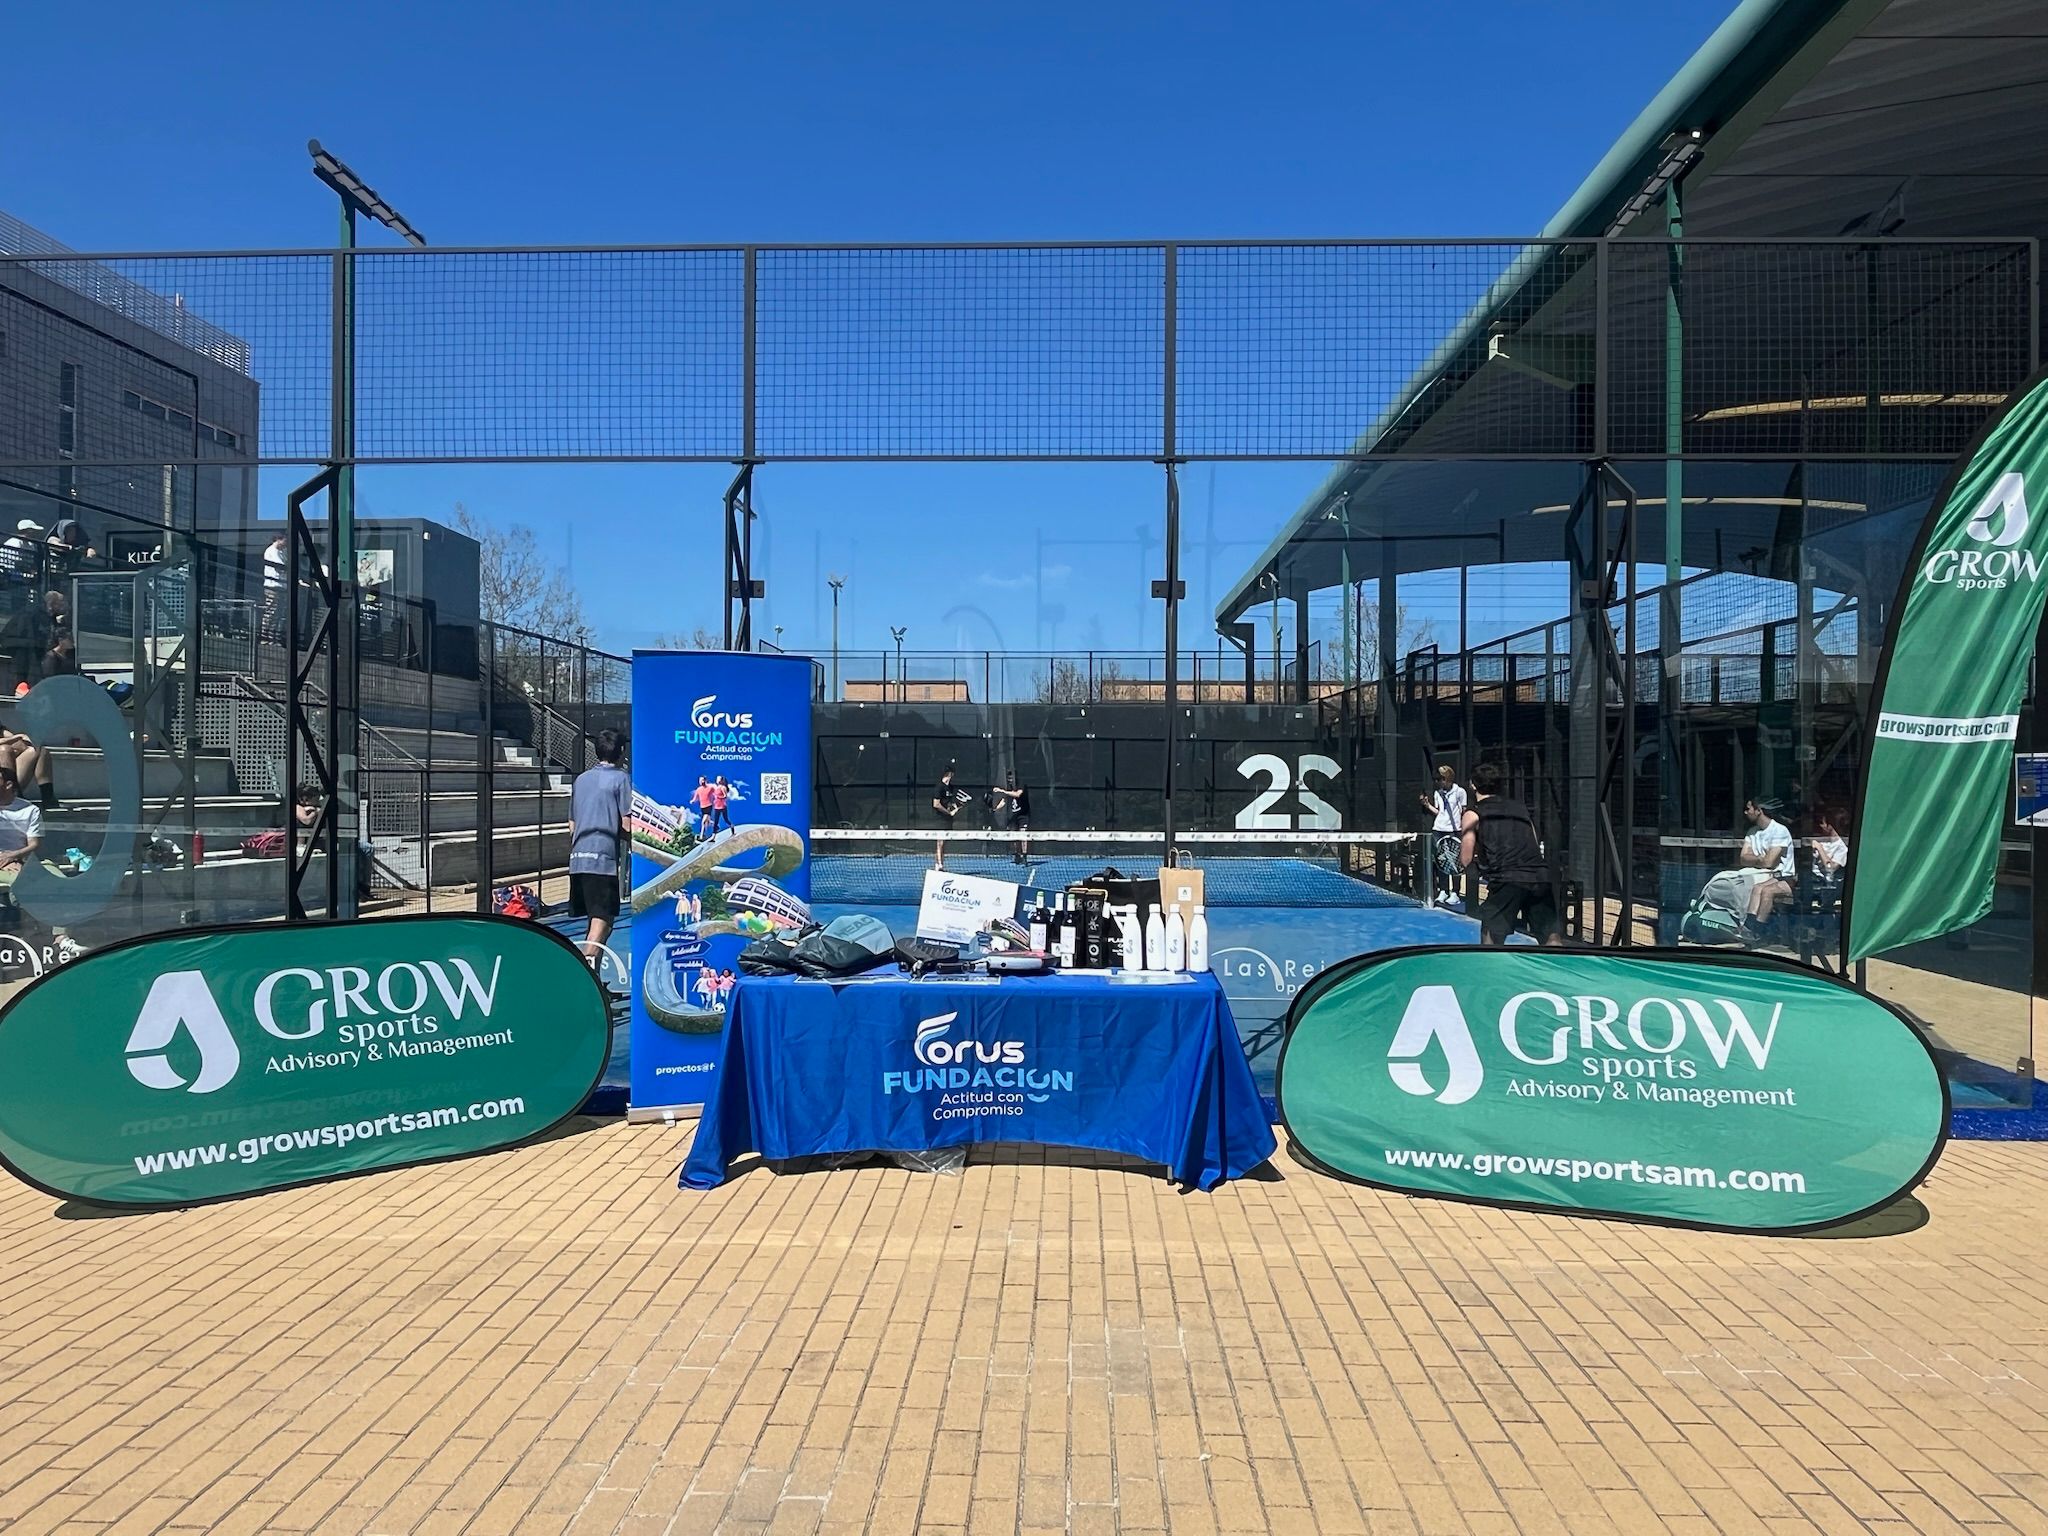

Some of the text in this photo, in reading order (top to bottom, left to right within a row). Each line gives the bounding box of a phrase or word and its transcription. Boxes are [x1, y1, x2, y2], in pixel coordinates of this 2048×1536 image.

[1925, 549, 2048, 584] GROW
[1956, 577, 2008, 592] sports
[691, 695, 753, 728] Forus
[700, 752, 753, 761] Compromiso
[705, 744, 736, 753] Actitud
[1223, 959, 1266, 977] Las
[253, 954, 503, 1040] GROW
[337, 1011, 440, 1050] sports
[914, 1011, 1026, 1066] Forus
[1498, 990, 1783, 1072] GROW
[264, 1027, 515, 1075] Advisory & Management
[1582, 1054, 1698, 1085] sports
[940, 1090, 1024, 1106] Actitud con
[1505, 1078, 1798, 1110] Advisory & Management
[932, 1105, 1024, 1121] Compromiso
[134, 1093, 526, 1176] www.growsportsam.com
[1384, 1146, 1806, 1194] www.growsportsam.com
